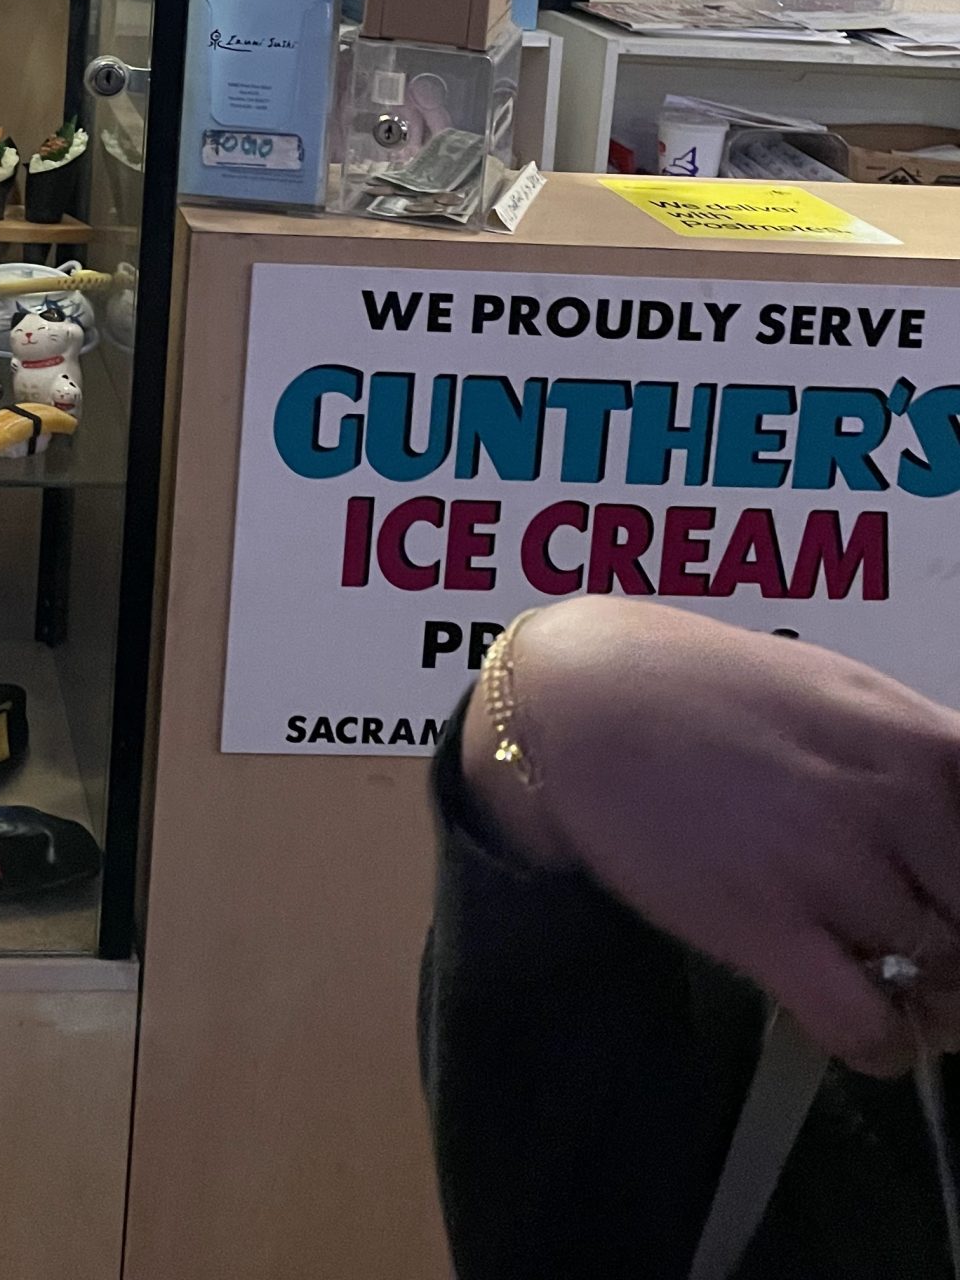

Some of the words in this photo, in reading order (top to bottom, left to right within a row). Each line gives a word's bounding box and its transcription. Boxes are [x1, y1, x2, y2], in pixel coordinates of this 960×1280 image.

[649, 200, 700, 210] We
[706, 203, 799, 213] deliver
[667, 211, 734, 220] with
[361, 290, 454, 333] WE
[471, 294, 742, 342] PROUDLY
[755, 304, 925, 348] SERVE
[273, 364, 960, 498] GUNTHER'S
[341, 496, 501, 592] ICE
[520, 500, 890, 600] CREAM
[286, 715, 445, 745] SACRAM
